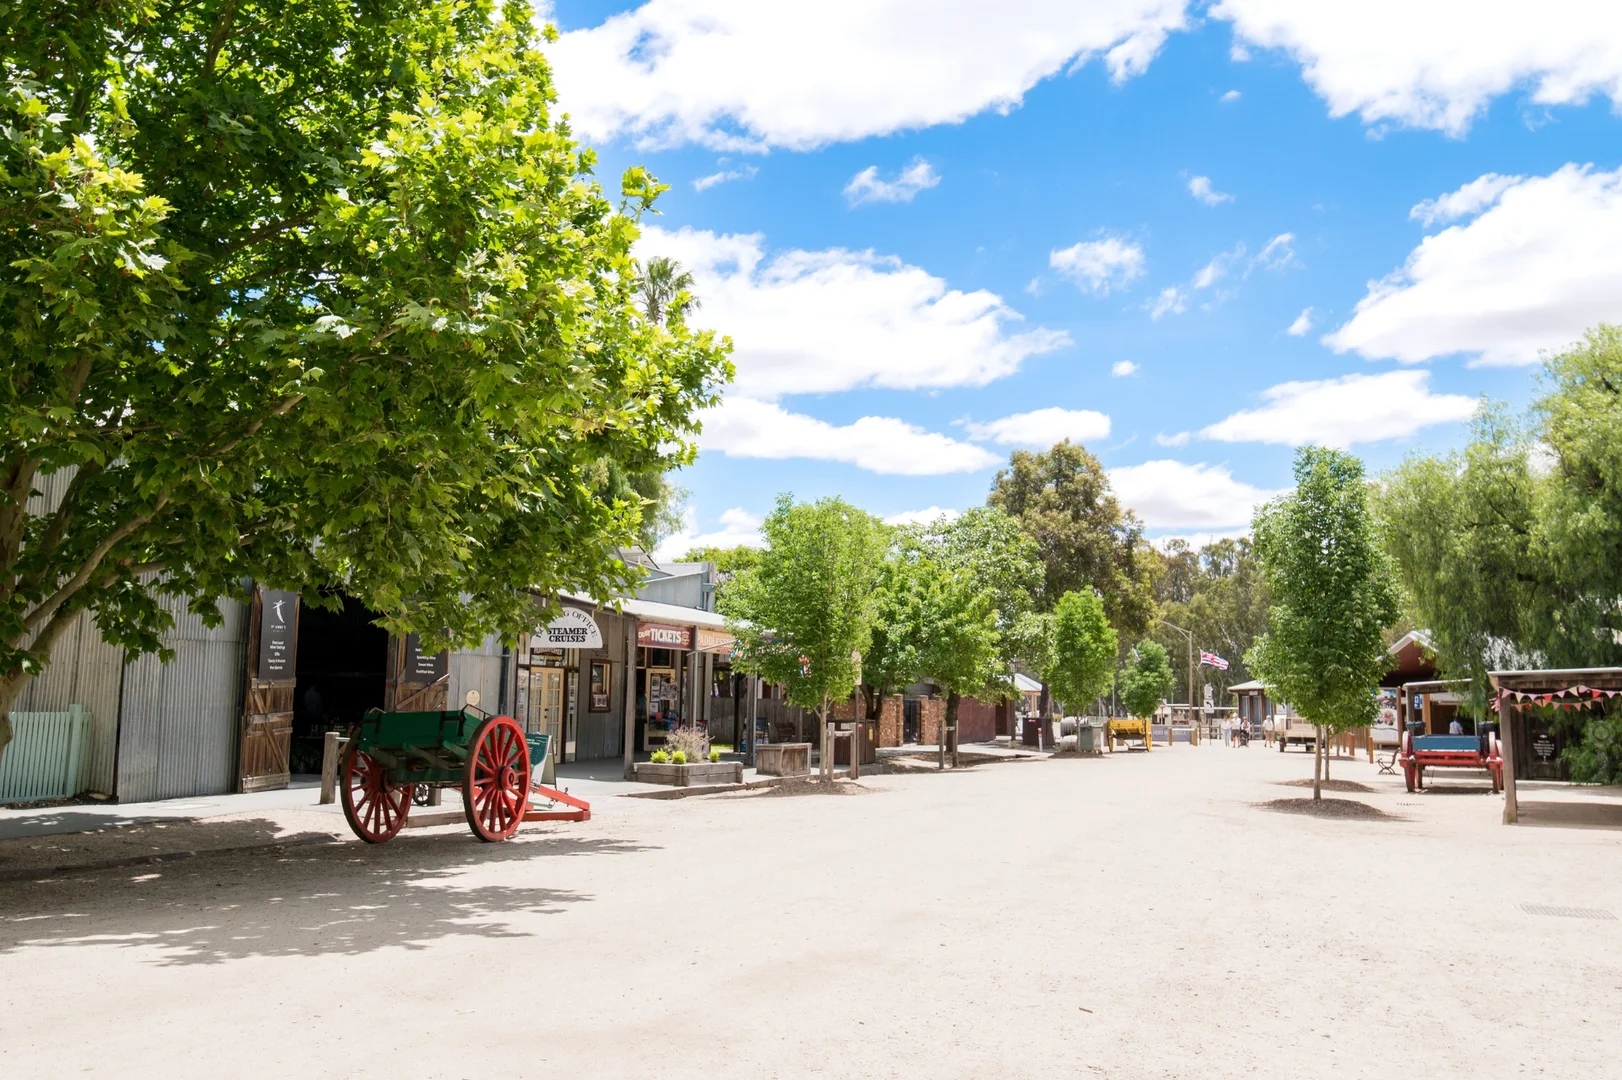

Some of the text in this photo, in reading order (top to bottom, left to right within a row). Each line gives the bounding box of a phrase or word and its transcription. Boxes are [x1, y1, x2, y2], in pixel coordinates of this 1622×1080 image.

[571, 610, 598, 638] OFFICE
[547, 627, 588, 635] STEAMER
[650, 627, 682, 645] TICKETS
[548, 635, 586, 643] CRUISES
